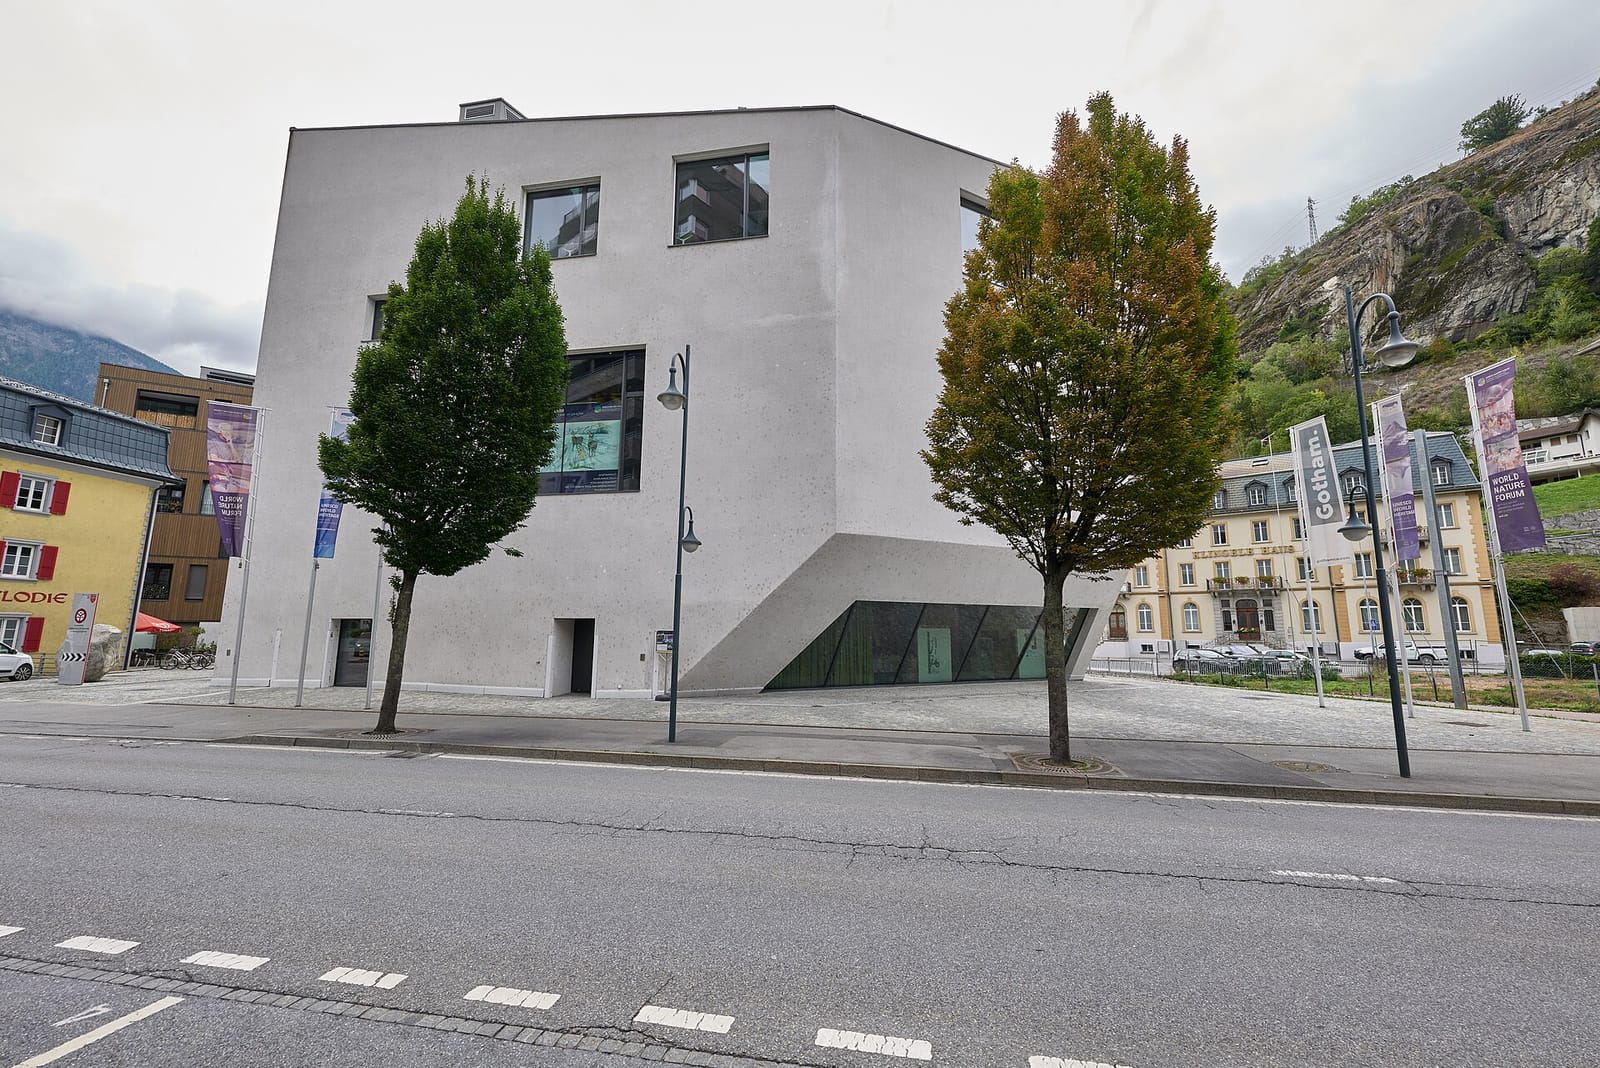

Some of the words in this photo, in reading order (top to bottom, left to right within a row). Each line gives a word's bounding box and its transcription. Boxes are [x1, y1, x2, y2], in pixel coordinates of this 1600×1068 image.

[1308, 430, 1334, 520] Gotham.
[1492, 473, 1520, 486] WORLD
[1493, 480, 1526, 494] NATURE
[1495, 489, 1525, 503] FORUM
[0, 591, 68, 604] LODIE
